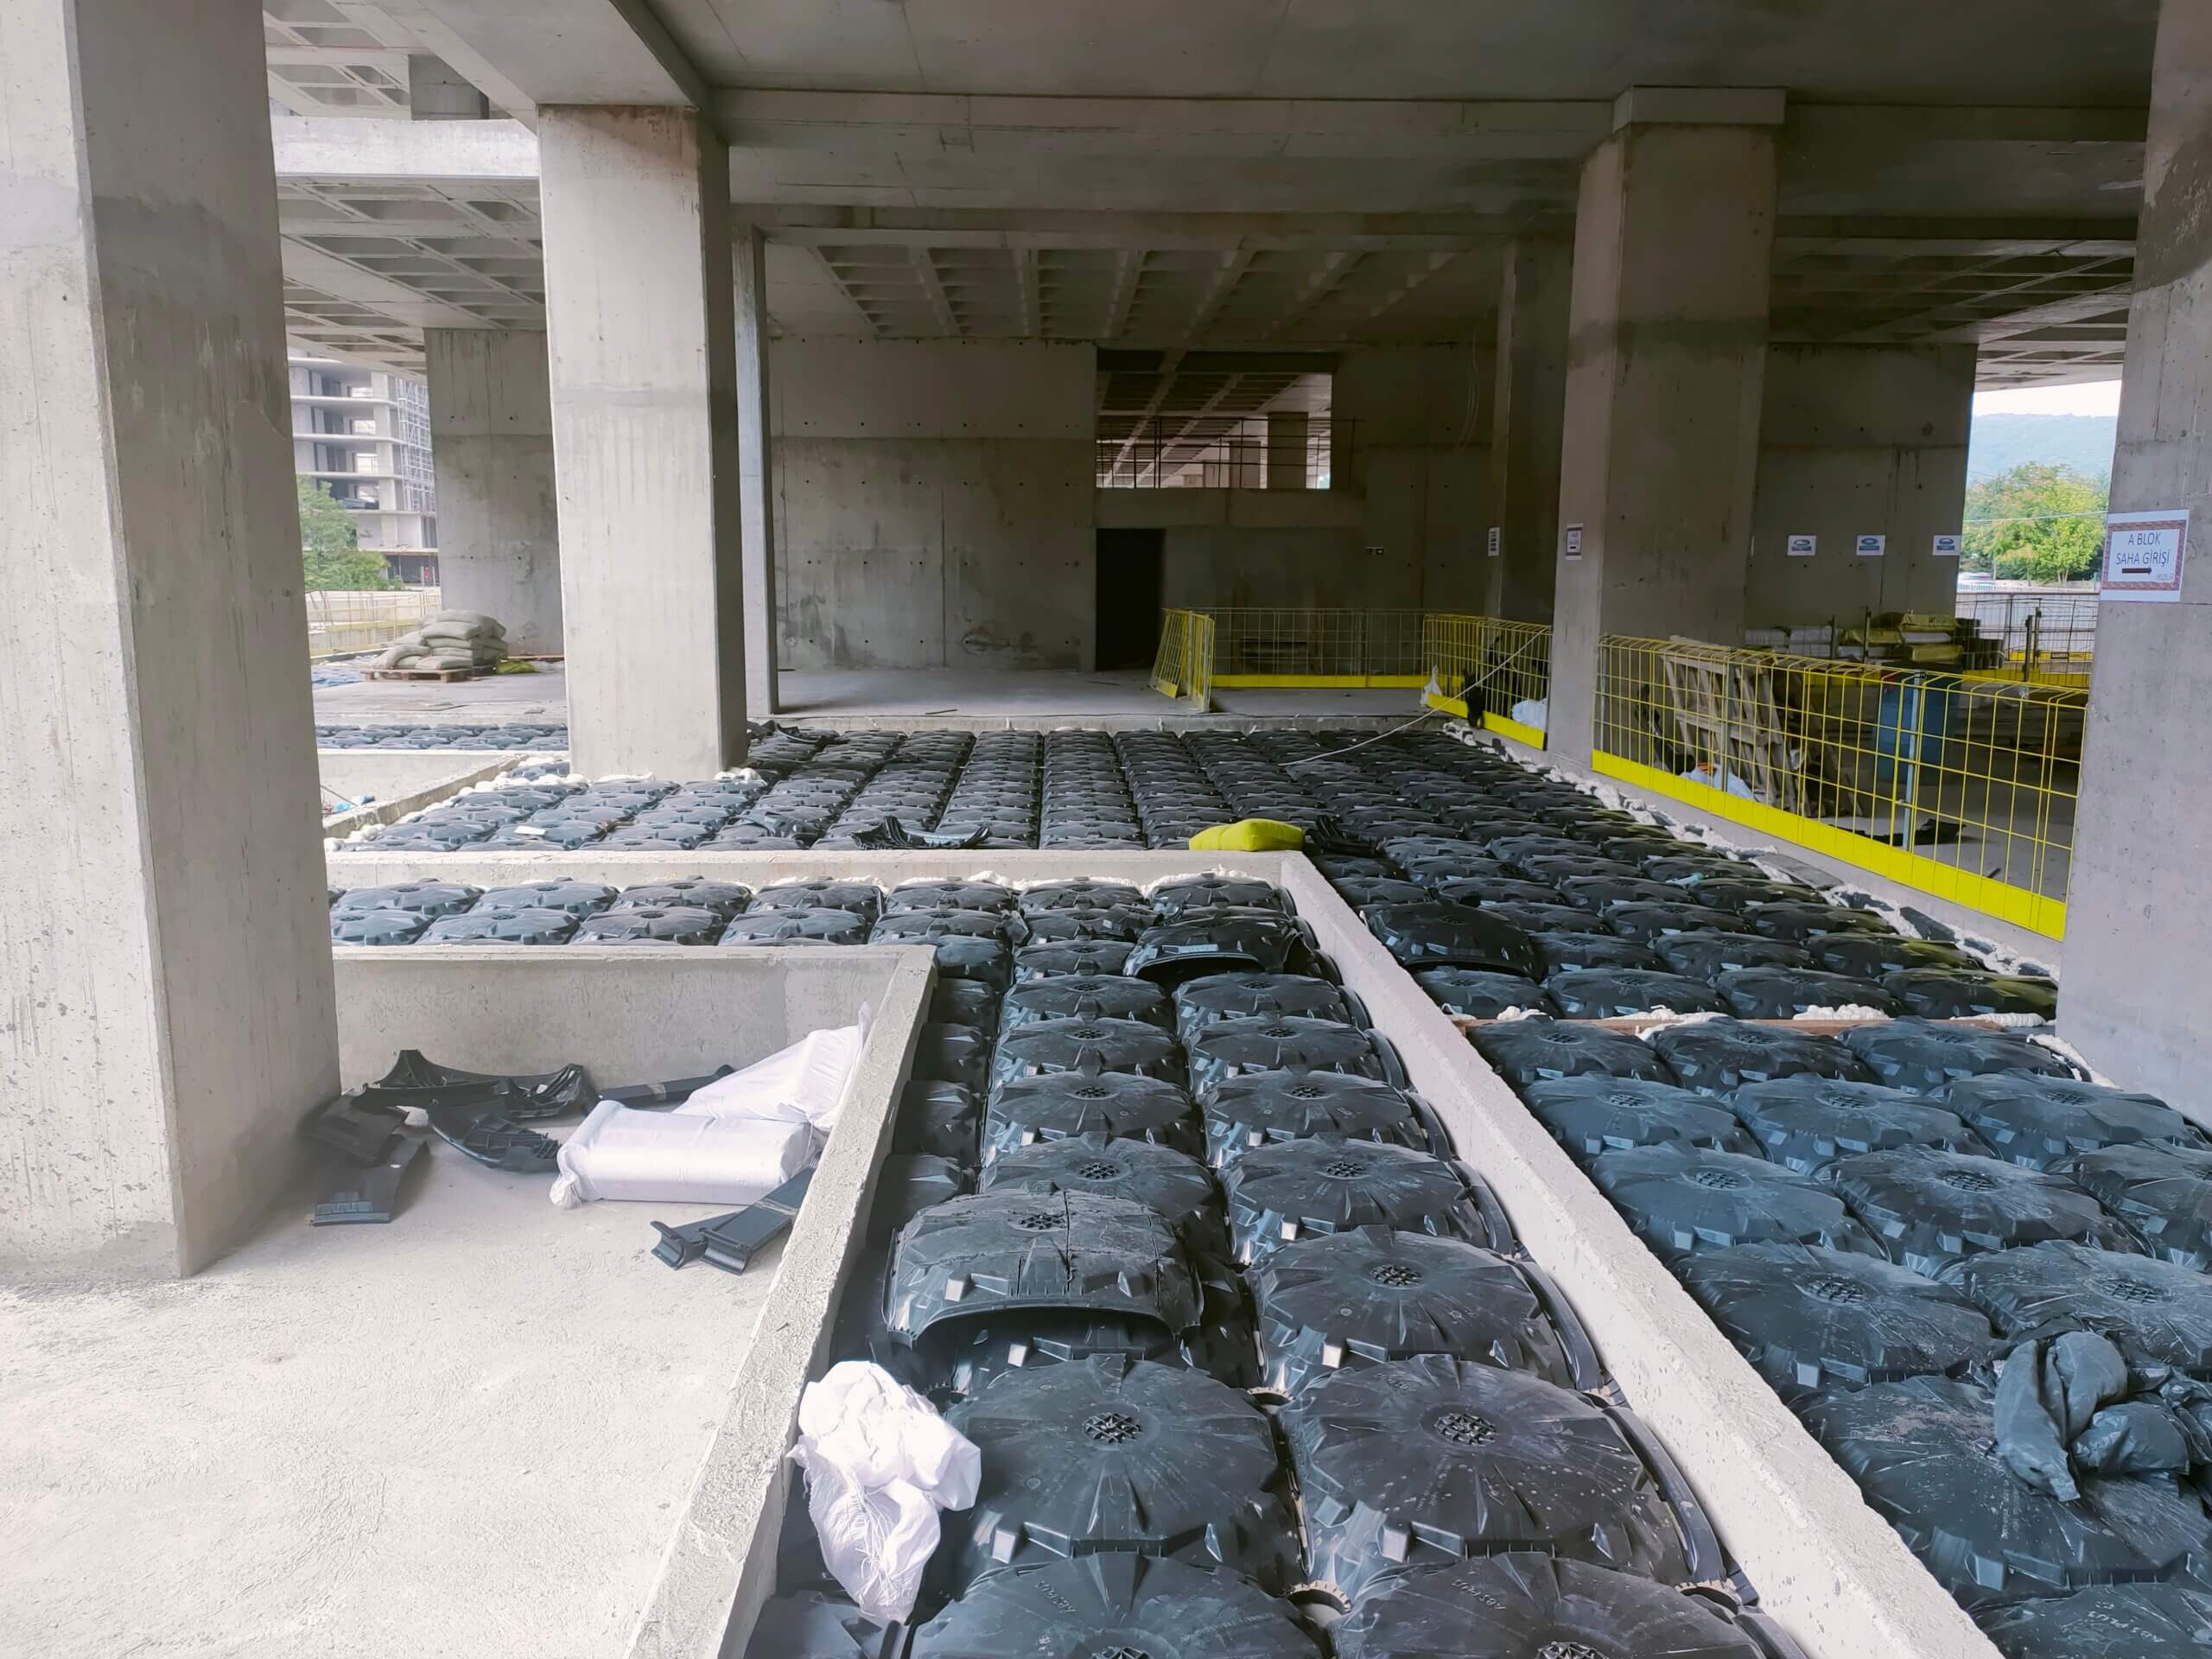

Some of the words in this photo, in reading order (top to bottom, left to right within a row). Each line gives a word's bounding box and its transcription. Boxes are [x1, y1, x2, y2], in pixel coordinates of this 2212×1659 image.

[2127, 532, 2134, 545] A
[2137, 532, 2161, 545] BLOK
[2115, 552, 2140, 565] SAHA
[2143, 549, 2171, 567] GİRİŞİ
